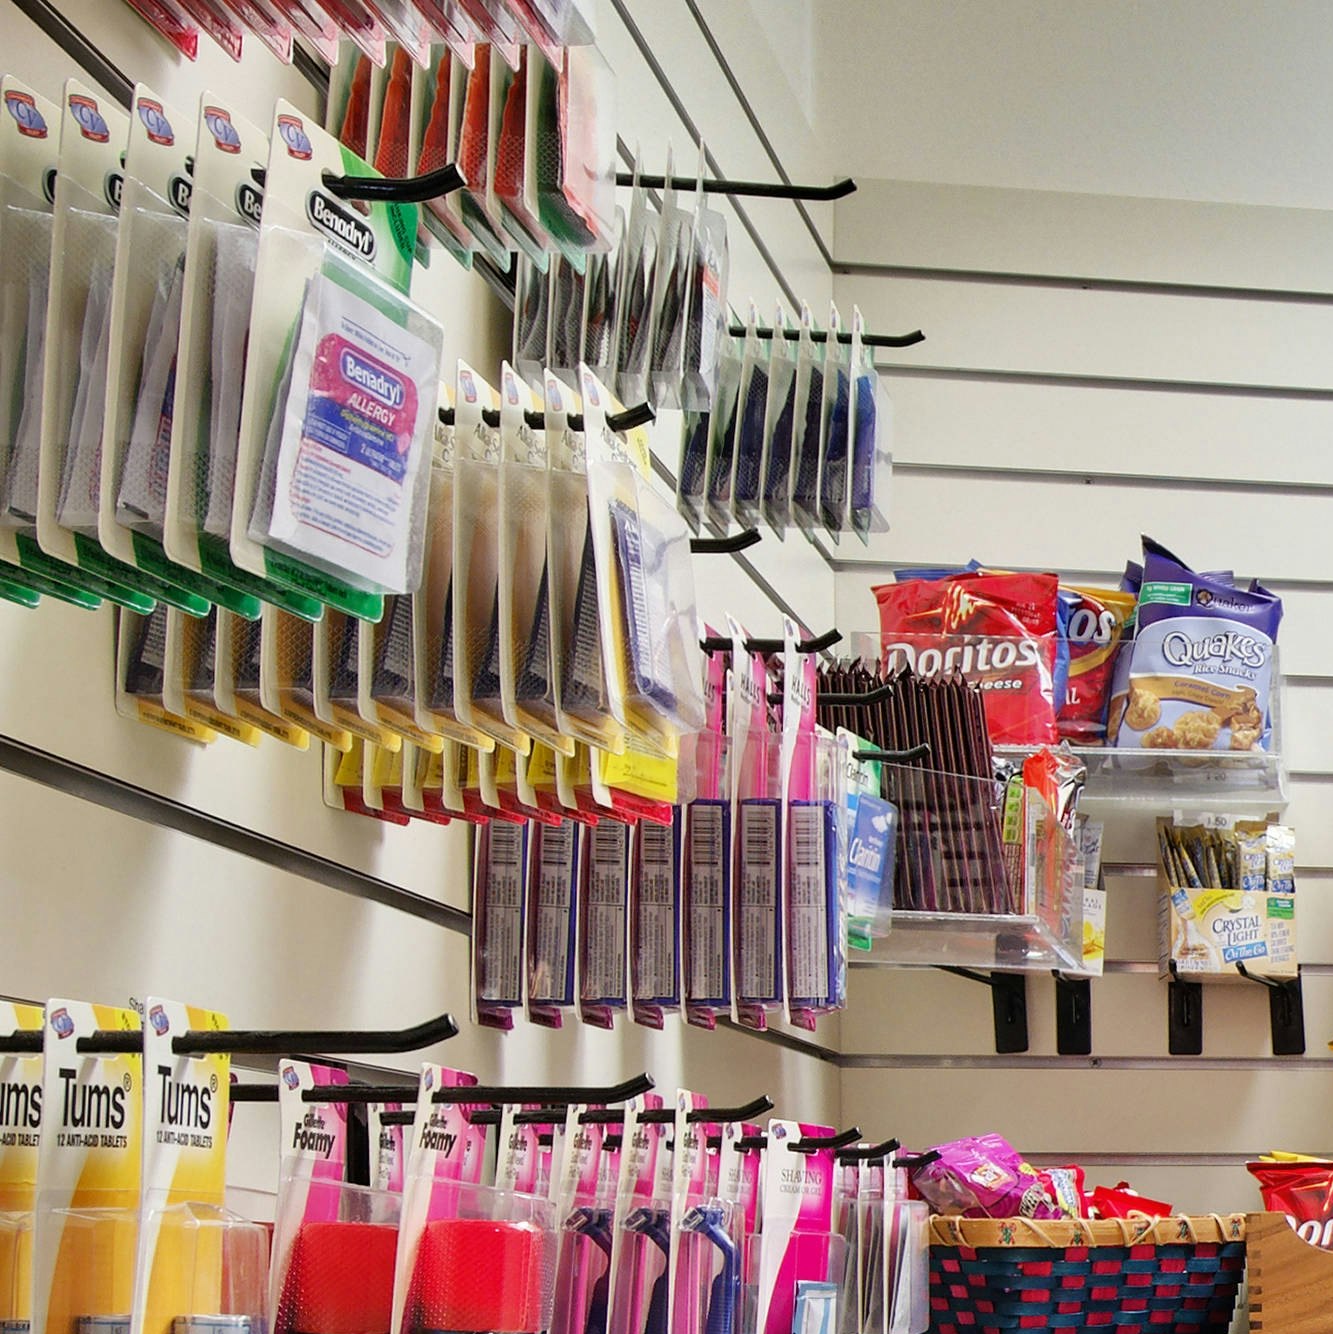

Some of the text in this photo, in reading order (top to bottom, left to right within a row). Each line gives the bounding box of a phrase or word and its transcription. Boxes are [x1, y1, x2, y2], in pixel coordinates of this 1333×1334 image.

[314, 196, 372, 254] Benadryl
[344, 356, 401, 405] Benadryl
[347, 393, 396, 427] ALLERGY
[886, 639, 1039, 678] Doritos
[1162, 630, 1266, 669] Quakes
[1193, 663, 1257, 681] Rice Snacks
[1212, 916, 1261, 934] CRYSTAL
[1227, 929, 1259, 946] LIGHT
[57, 1134, 128, 1148] 12 ANTI-ACID TABLETS
[164, 1131, 213, 1149] ANTI-ACID TABLETS
[293, 1122, 336, 1159] Foamy
[419, 1122, 457, 1159] Foamy
[781, 1169, 822, 1185] SHAVING
